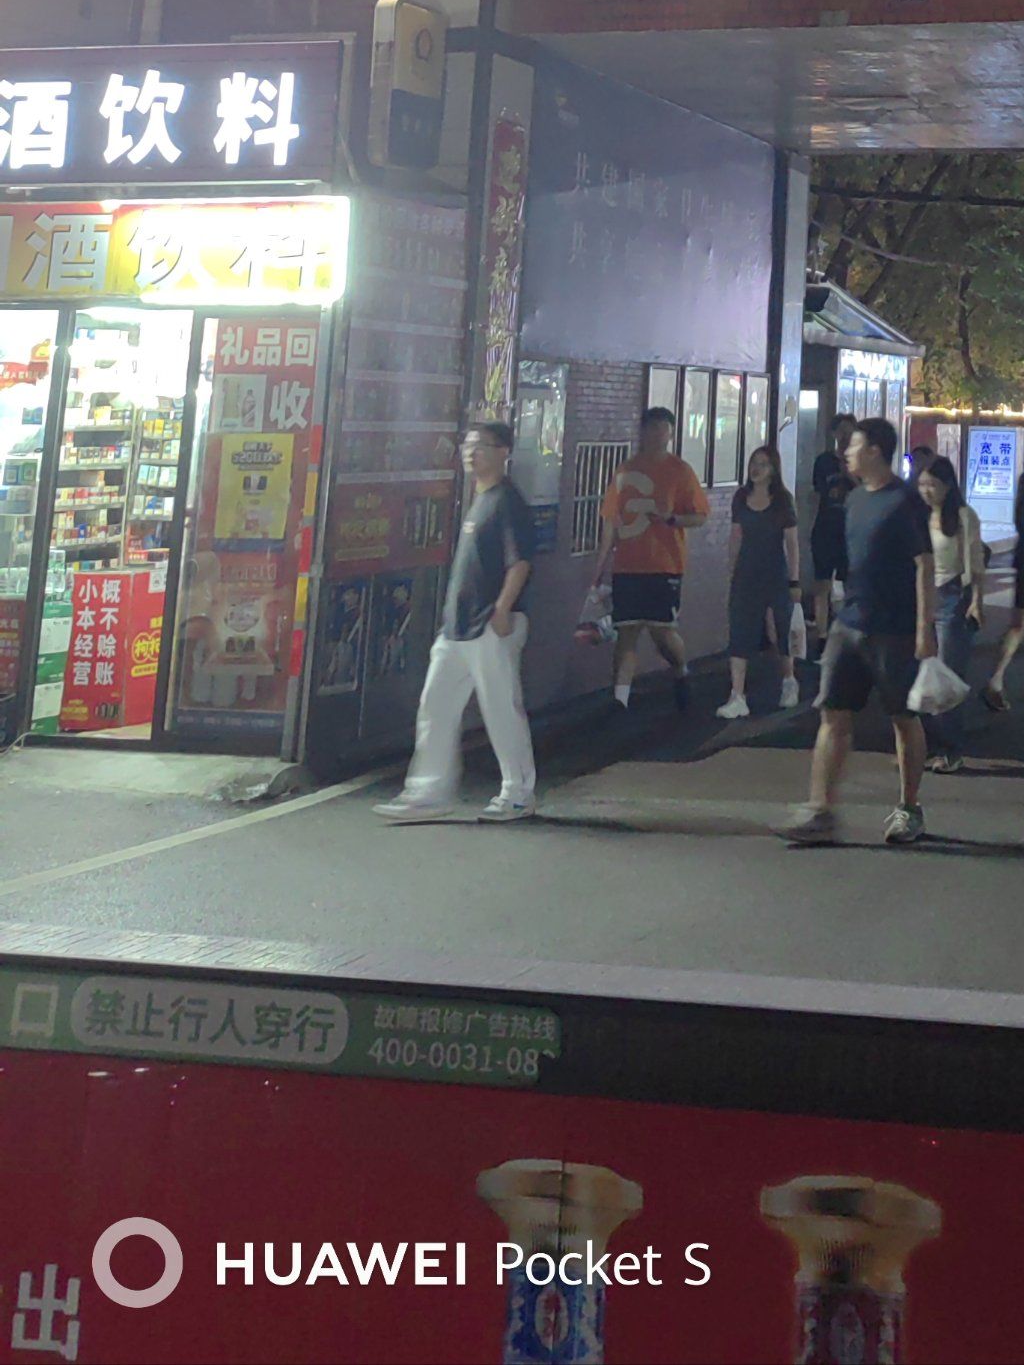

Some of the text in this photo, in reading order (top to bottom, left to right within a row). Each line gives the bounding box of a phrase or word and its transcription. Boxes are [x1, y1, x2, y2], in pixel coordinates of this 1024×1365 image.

[0, 70, 300, 170] 酒饮料
[0, 208, 331, 290] 酒饮料
[220, 326, 316, 367] 礼品回
[270, 381, 310, 430] 收
[73, 579, 98, 687] 小本经营
[94, 579, 121, 687] 概不赊账
[84, 988, 337, 1055] 禁止行人穿行
[368, 1036, 557, 1077] 400-0031-08
[12, 1264, 81, 1362] 出
